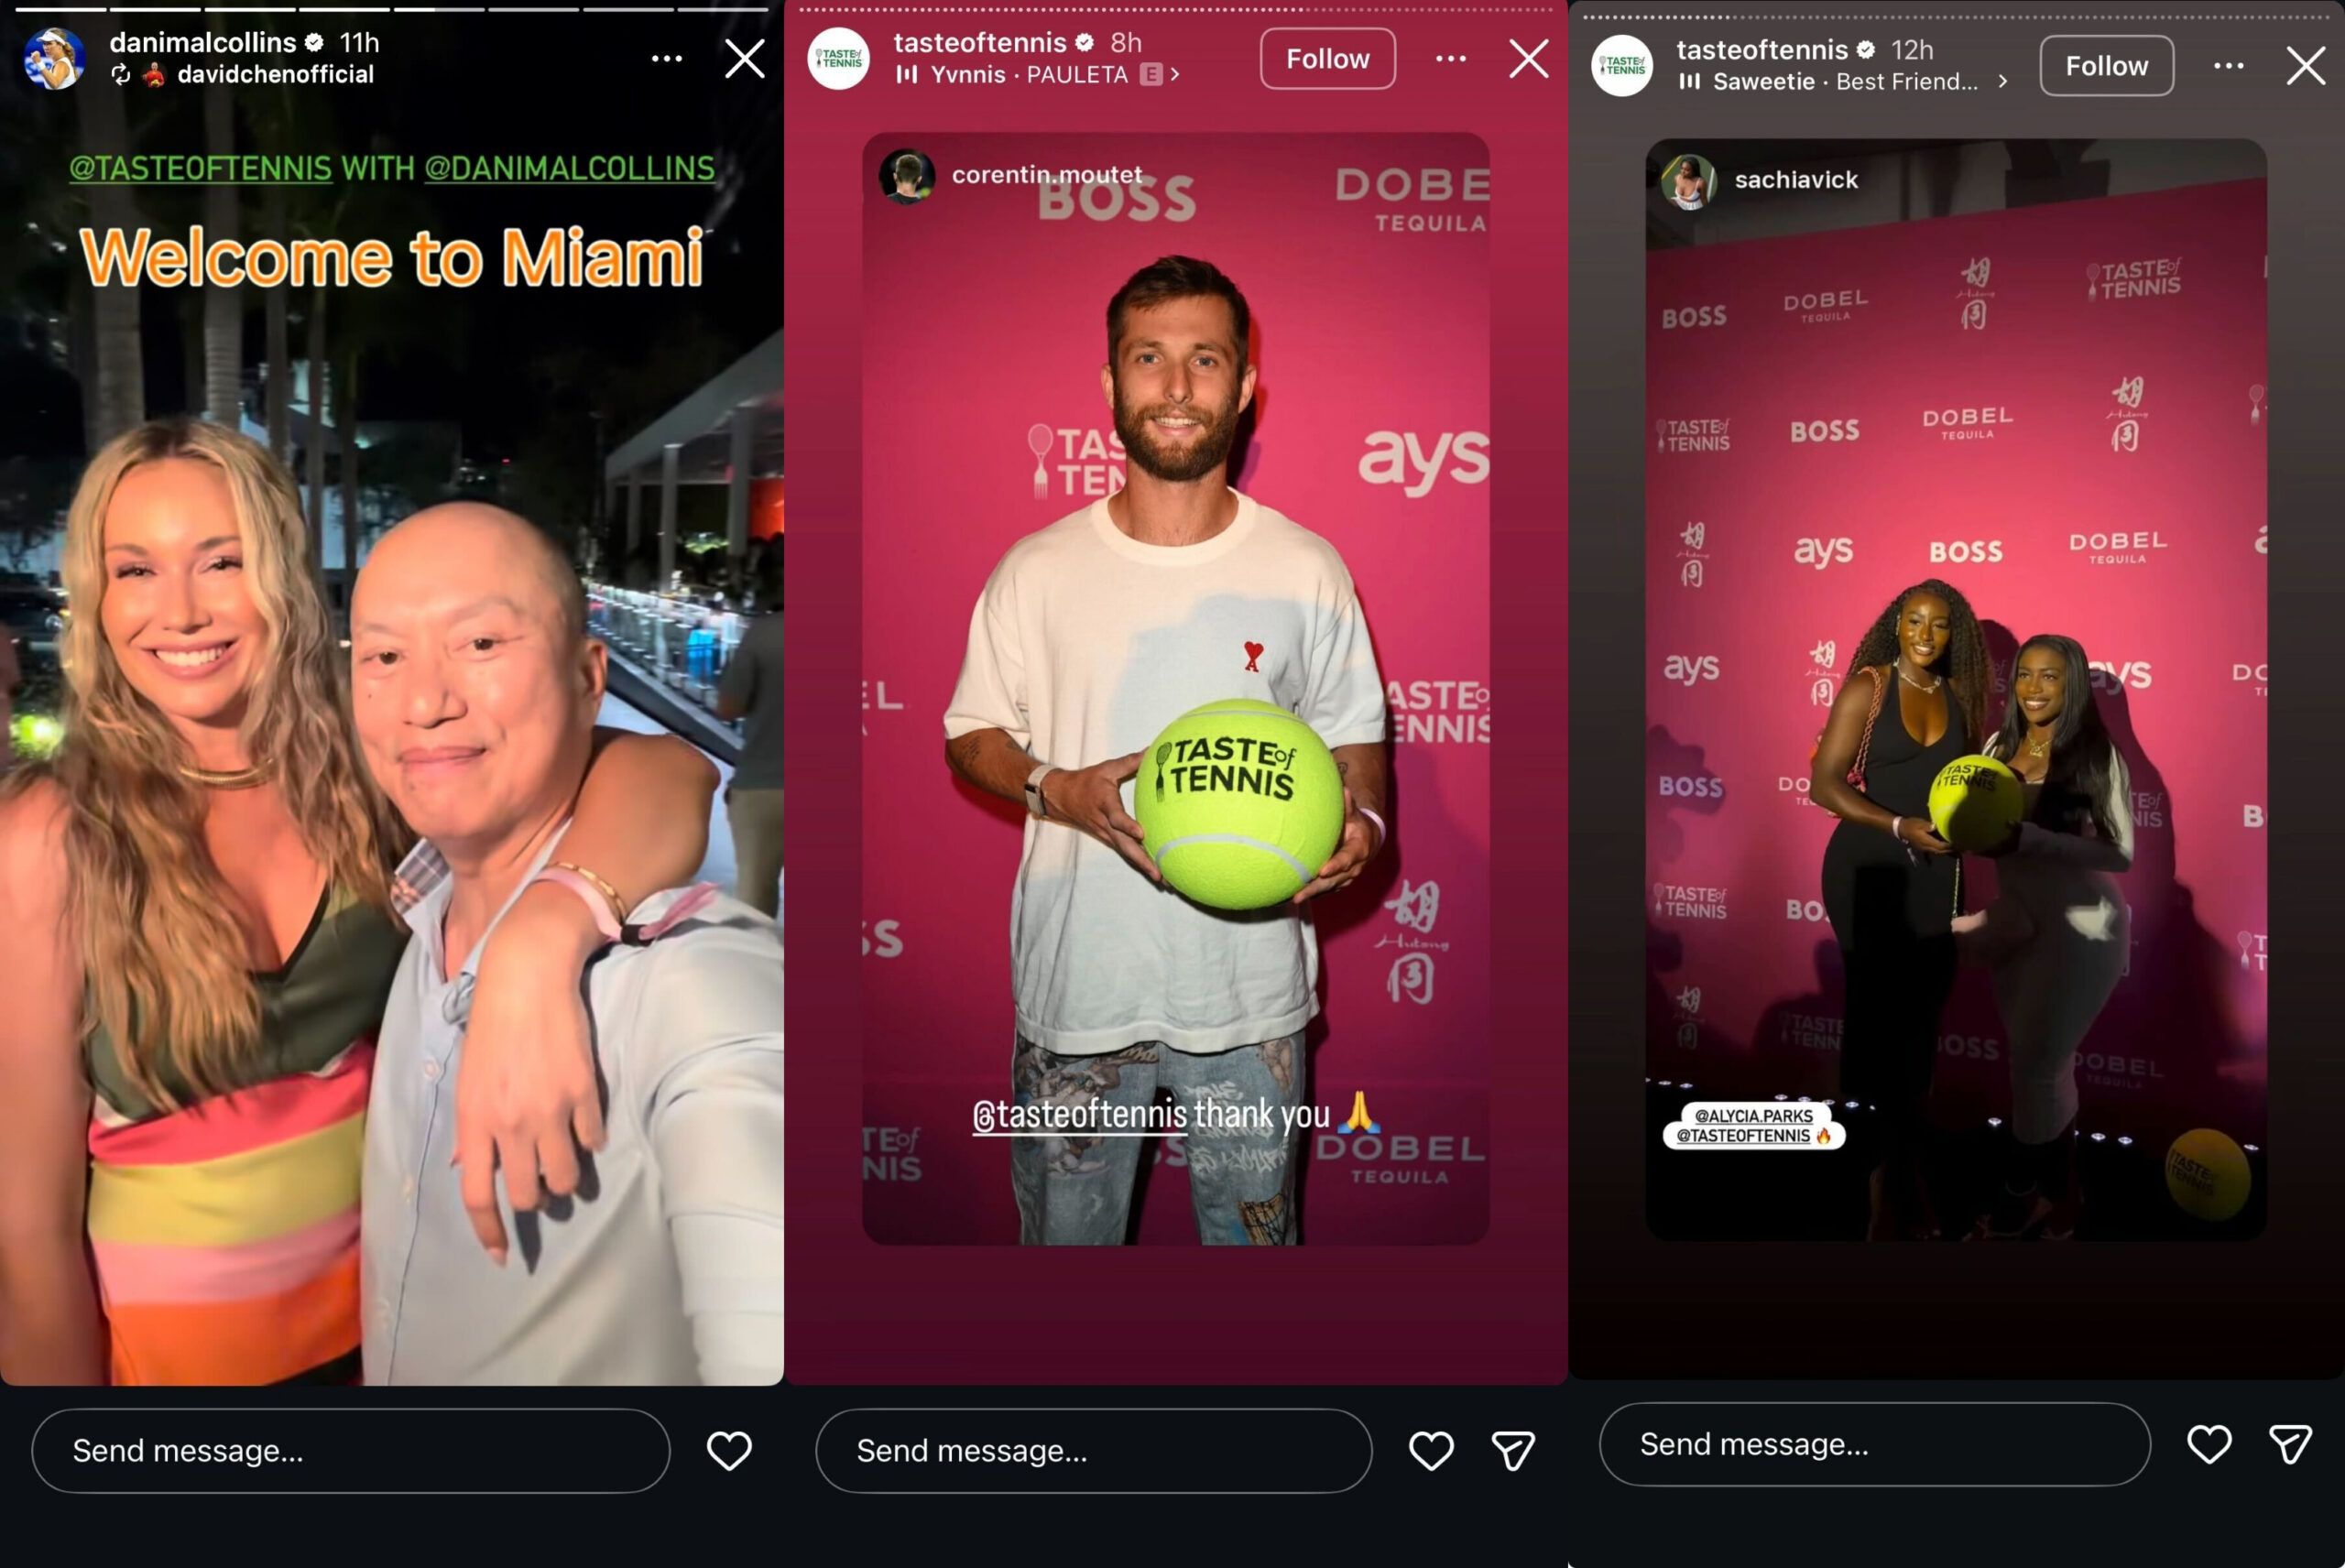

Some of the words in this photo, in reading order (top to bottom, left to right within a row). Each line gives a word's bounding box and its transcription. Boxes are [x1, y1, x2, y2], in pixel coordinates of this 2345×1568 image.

[1336, 168, 1490, 201] DOBE
[1039, 174, 1196, 222] BOSS
[1376, 214, 1487, 232] TEQUILA
[2101, 277, 2182, 299] TENNIS
[1783, 289, 1869, 311] DOBEL
[1662, 305, 1728, 329] BOSS
[1801, 311, 1851, 323] TEQUILA
[1923, 407, 2014, 427] DOBEL
[1791, 419, 1860, 442] BOSS
[1941, 430, 1995, 441] TEQUILA
[1057, 429, 1127, 461] TAS
[1668, 436, 1730, 452] TENNIS
[1358, 430, 1490, 498] ays
[1057, 465, 1127, 495] TEN
[1929, 540, 2003, 563] BOSS
[2069, 531, 2168, 551] DOBEL
[1794, 537, 1854, 570] ays
[2089, 555, 2147, 565] TEQUILA
[1663, 655, 1720, 686] ays
[1387, 681, 1480, 710] ASTE
[1393, 714, 1490, 744] ENNIS
[1171, 765, 1295, 801] TENNIS
[1659, 776, 1724, 798] BOSS
[1666, 902, 1728, 920] TENNIS
[1787, 899, 1831, 923] BO
[1792, 1031, 1841, 1051] TENN
[1937, 1034, 2000, 1061] OSS
[1316, 1135, 1486, 1161] DOBEL
[862, 1157, 922, 1181] NIS
[1351, 1171, 1449, 1184] TEQUILA
